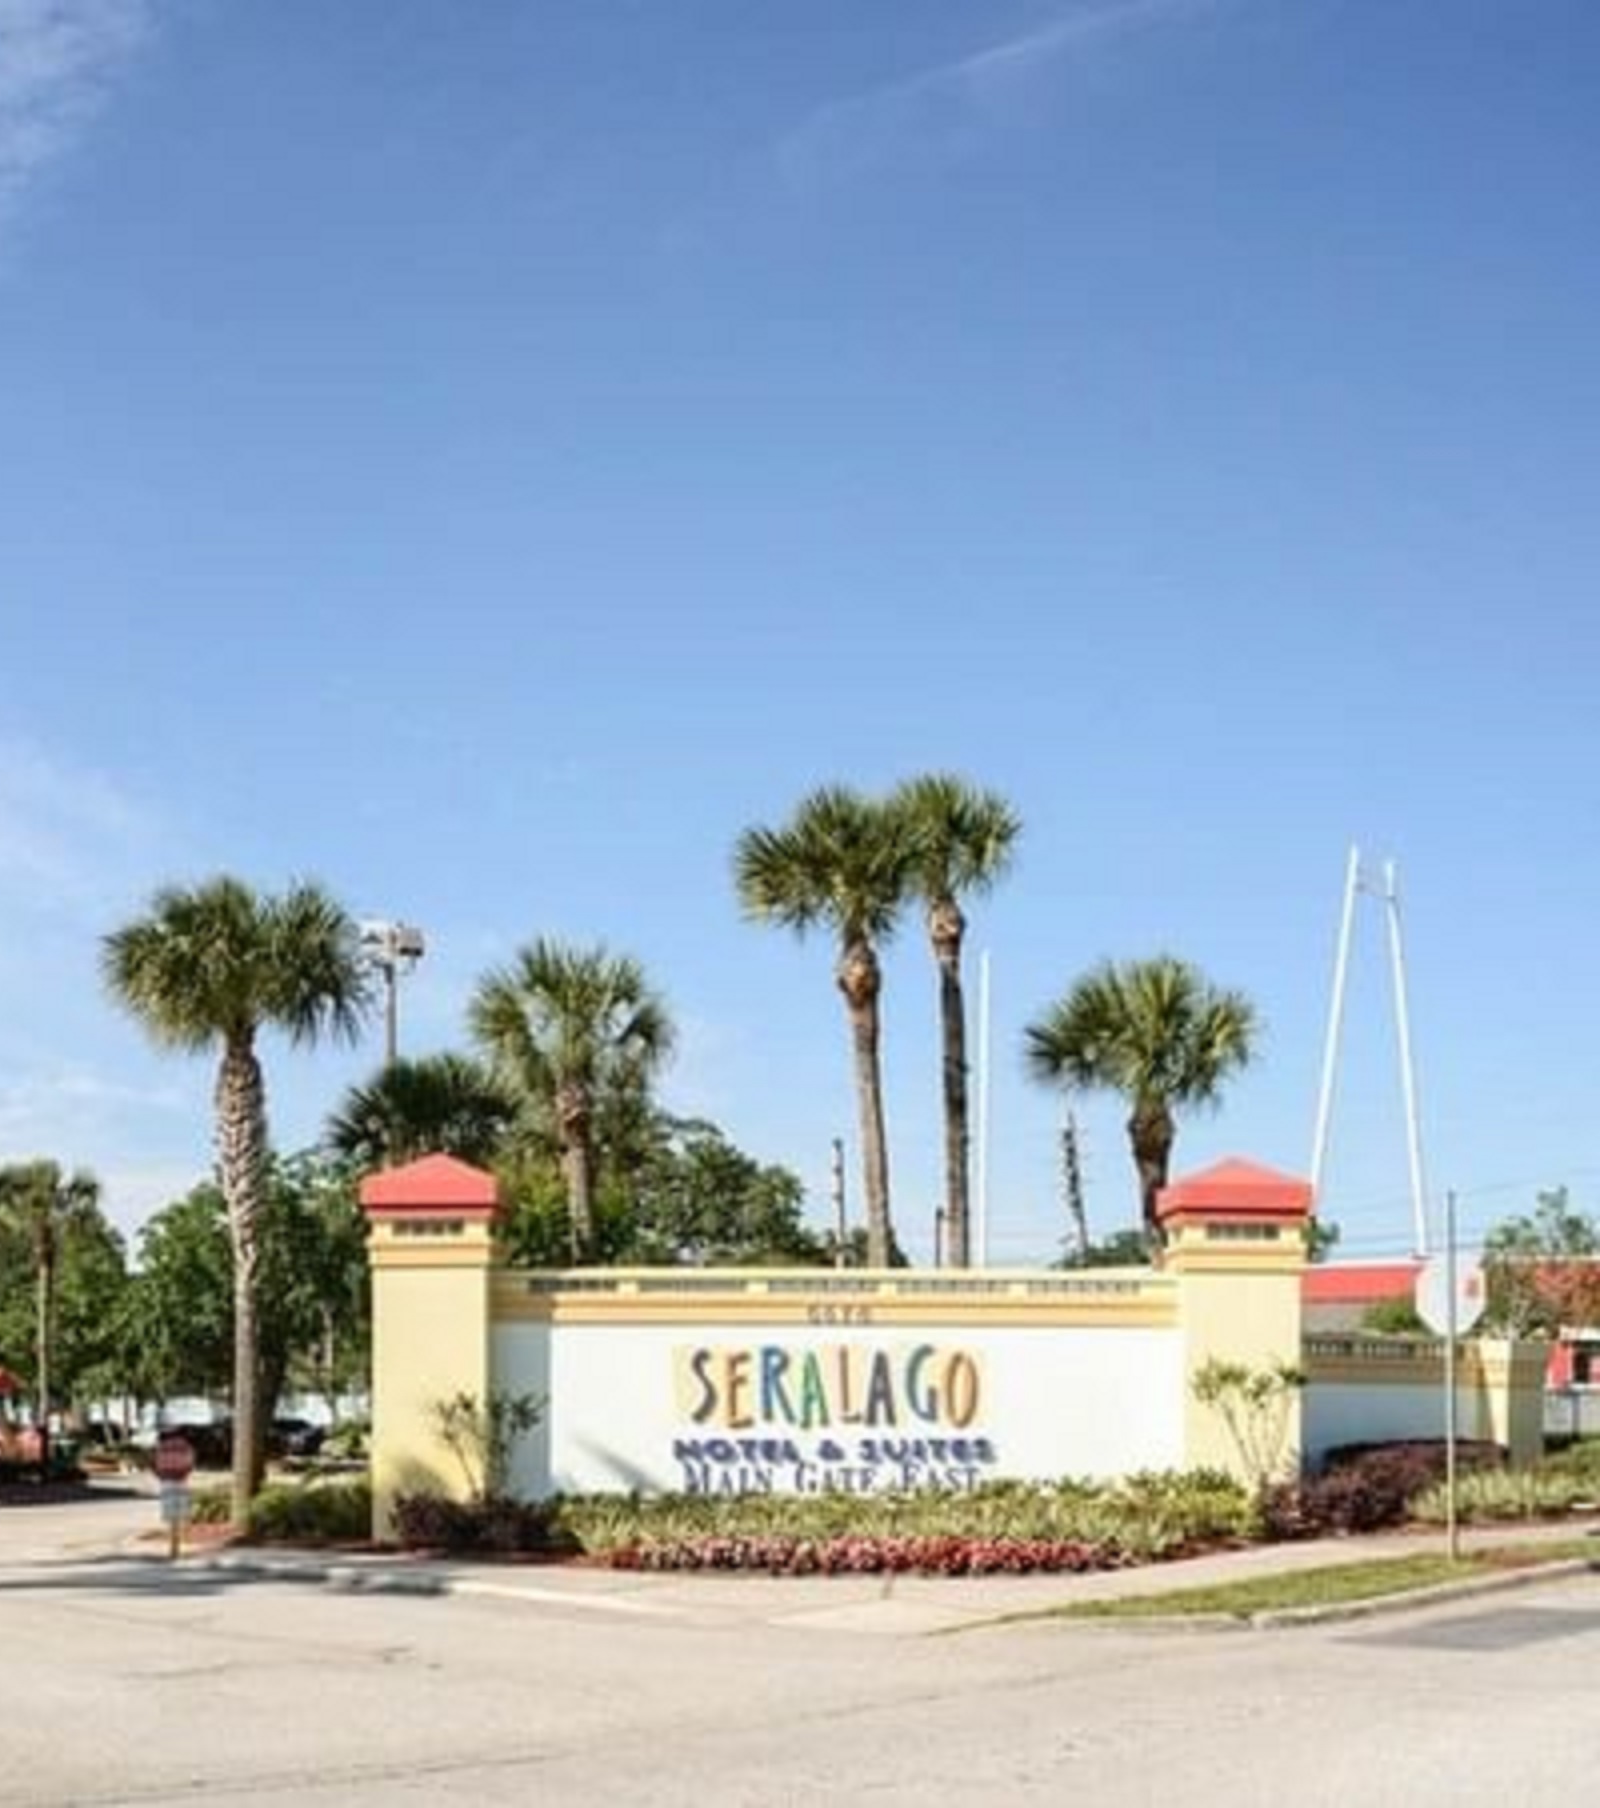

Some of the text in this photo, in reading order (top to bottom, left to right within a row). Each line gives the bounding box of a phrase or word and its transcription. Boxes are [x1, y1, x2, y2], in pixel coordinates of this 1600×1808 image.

[691, 1345, 979, 1429] SERALAGO
[672, 1439, 999, 1465] HOTEL & SUITES
